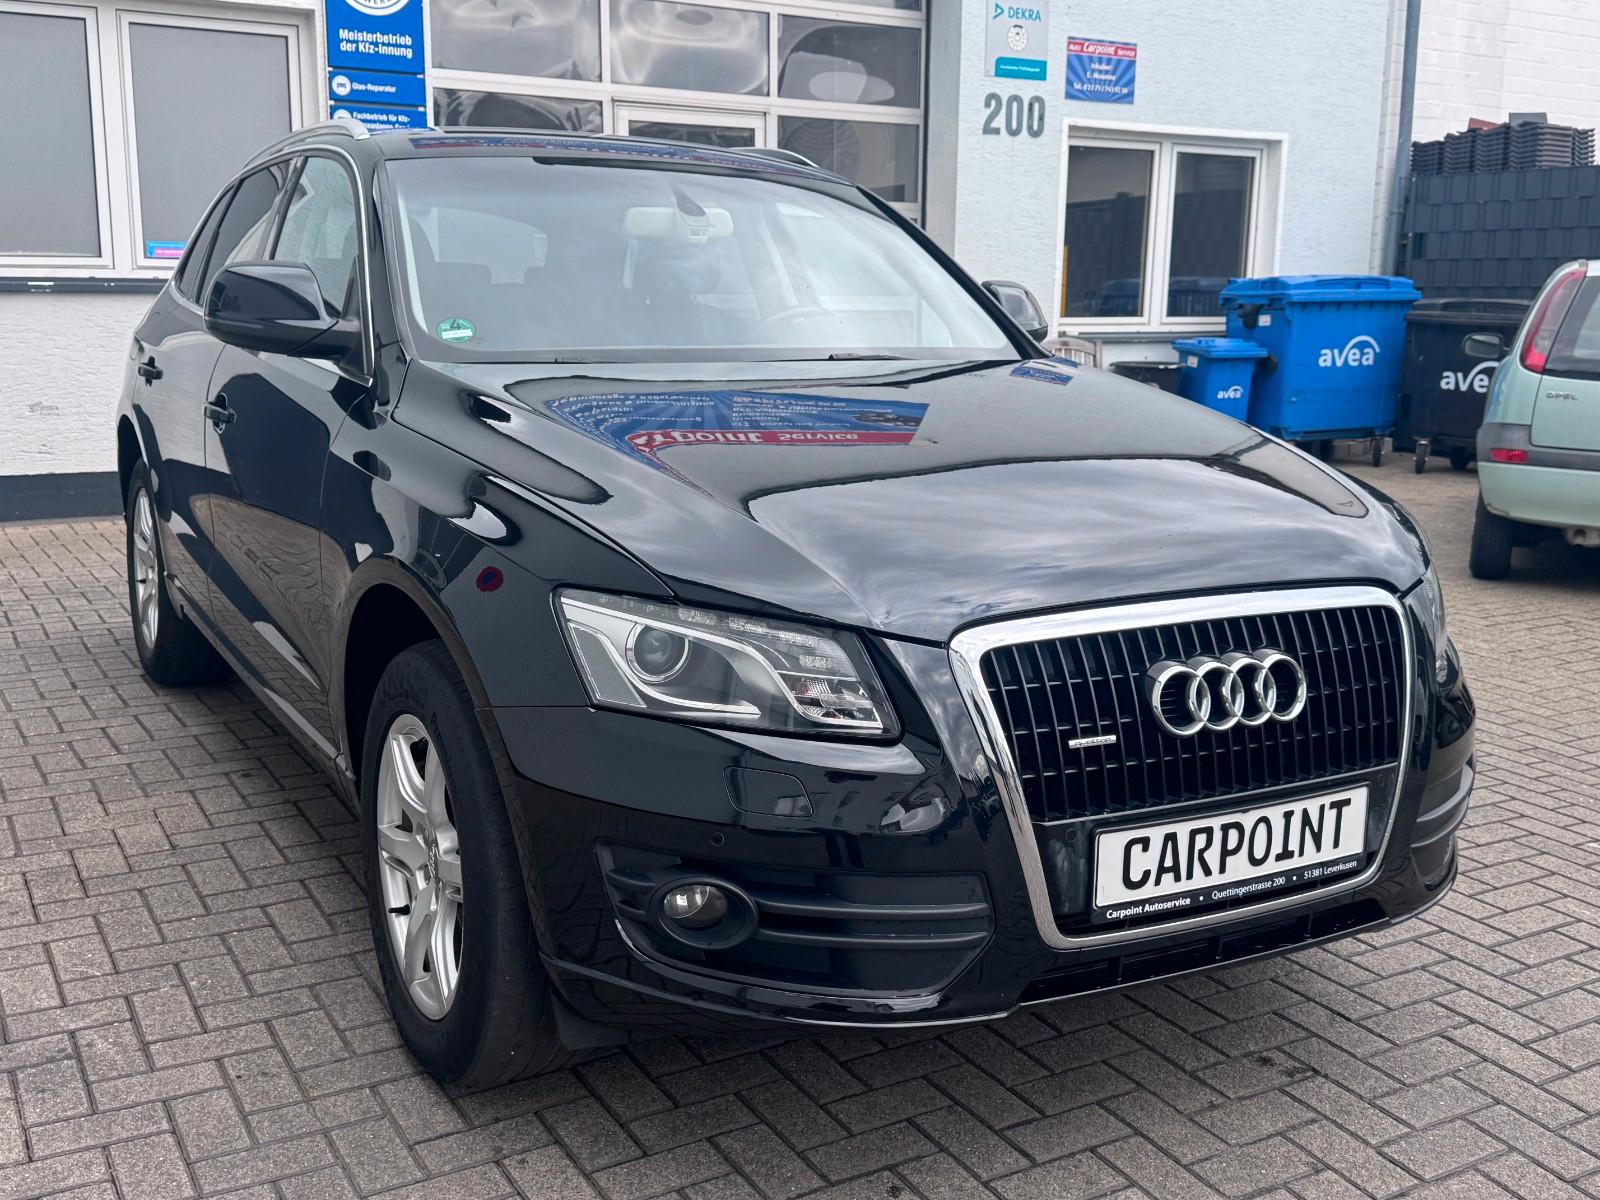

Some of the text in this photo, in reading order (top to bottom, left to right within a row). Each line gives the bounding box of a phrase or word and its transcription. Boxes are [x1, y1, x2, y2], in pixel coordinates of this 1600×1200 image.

[1008, 6, 1042, 22] DEKRA
[339, 28, 412, 46] Meisterbetrieb
[340, 41, 412, 59] der Kfz-Innung
[1083, 42, 1115, 55] Carpoint
[351, 82, 397, 93] Glas-Reparatur
[982, 92, 1046, 138] 200
[450, 319, 461, 329] 4
[1318, 335, 1380, 368] avea
[1440, 361, 1500, 393] ave
[1216, 386, 1243, 400] avea
[1122, 798, 1352, 890] CARPOINT
[1106, 860, 1357, 919] Carpoint Autoservice Quettingerstrasse 200 51381 Leverkusen
